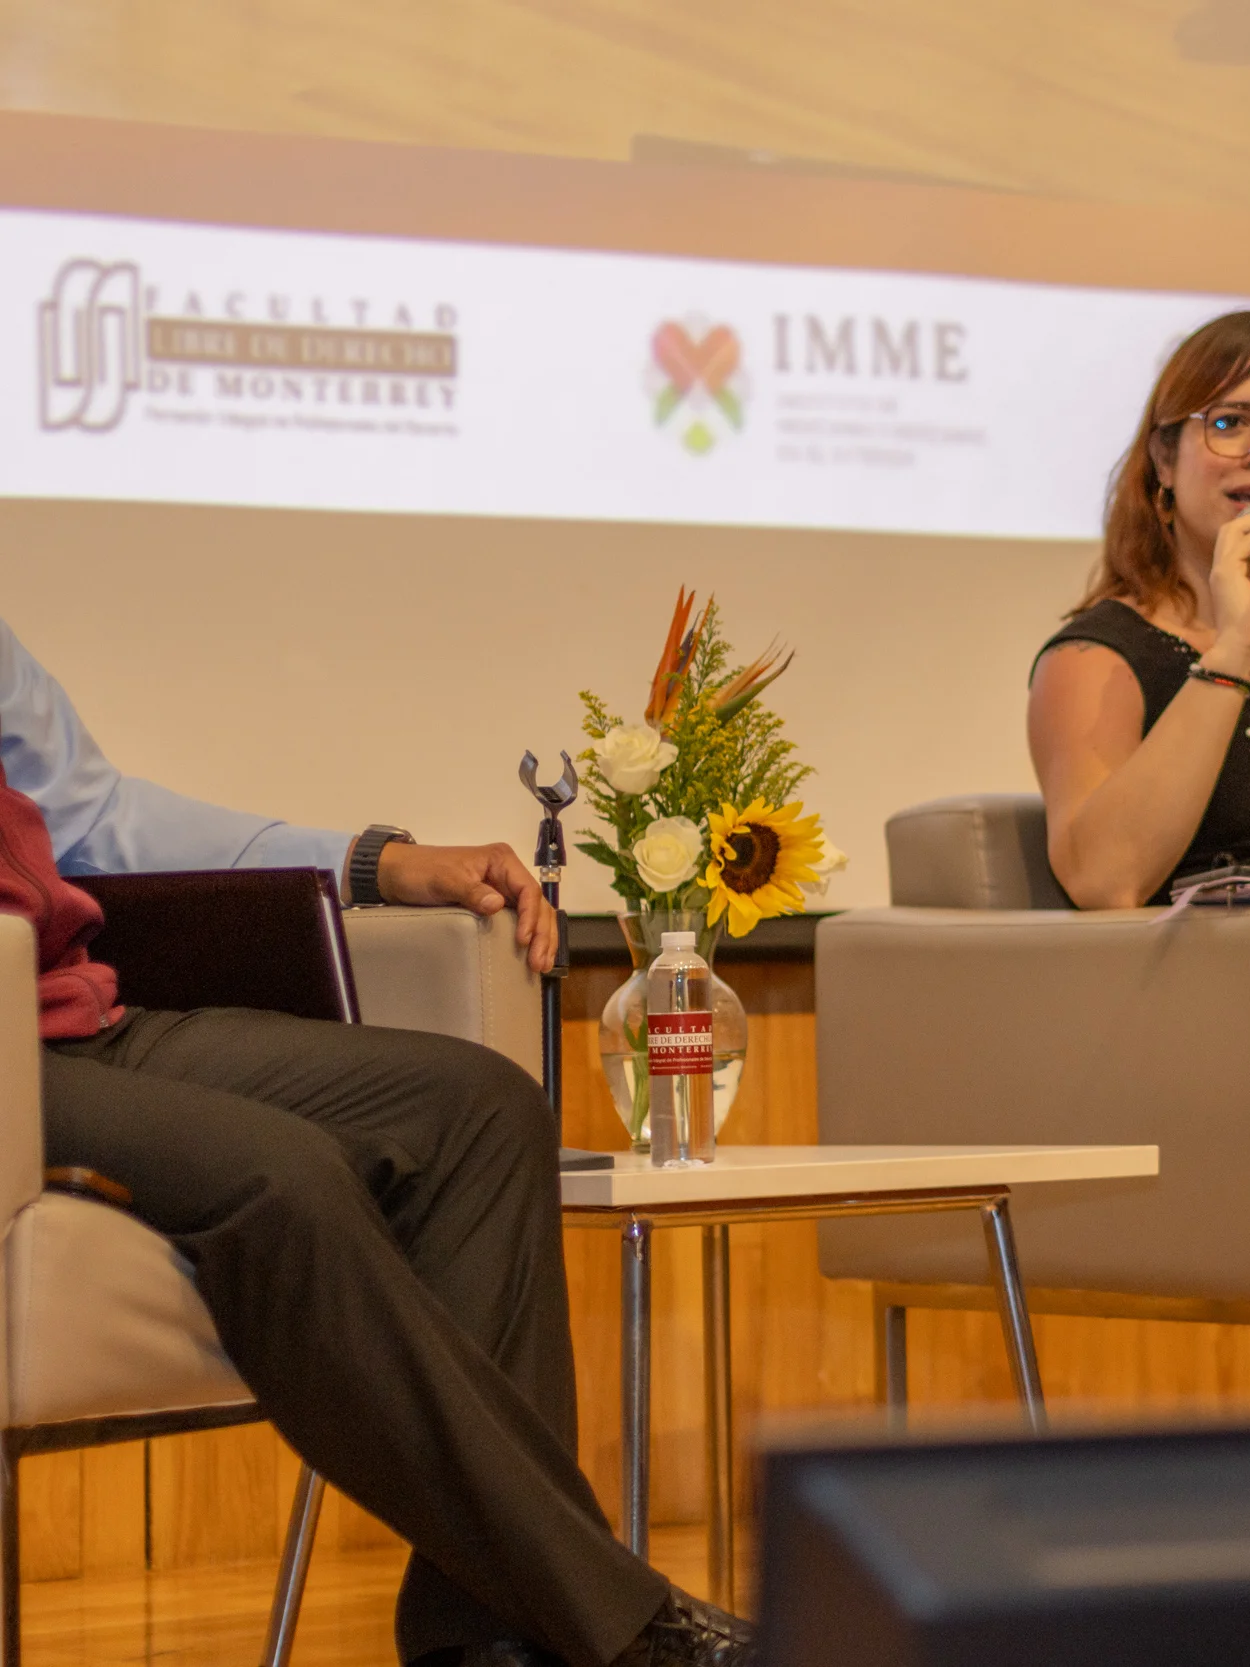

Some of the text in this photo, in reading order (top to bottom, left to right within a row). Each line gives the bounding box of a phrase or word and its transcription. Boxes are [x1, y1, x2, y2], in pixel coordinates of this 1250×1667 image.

[146, 285, 458, 330] FACULTAD
[772, 313, 970, 384] IMME
[147, 366, 457, 410] DE MONTERREY
[660, 1036, 673, 1045] DE
